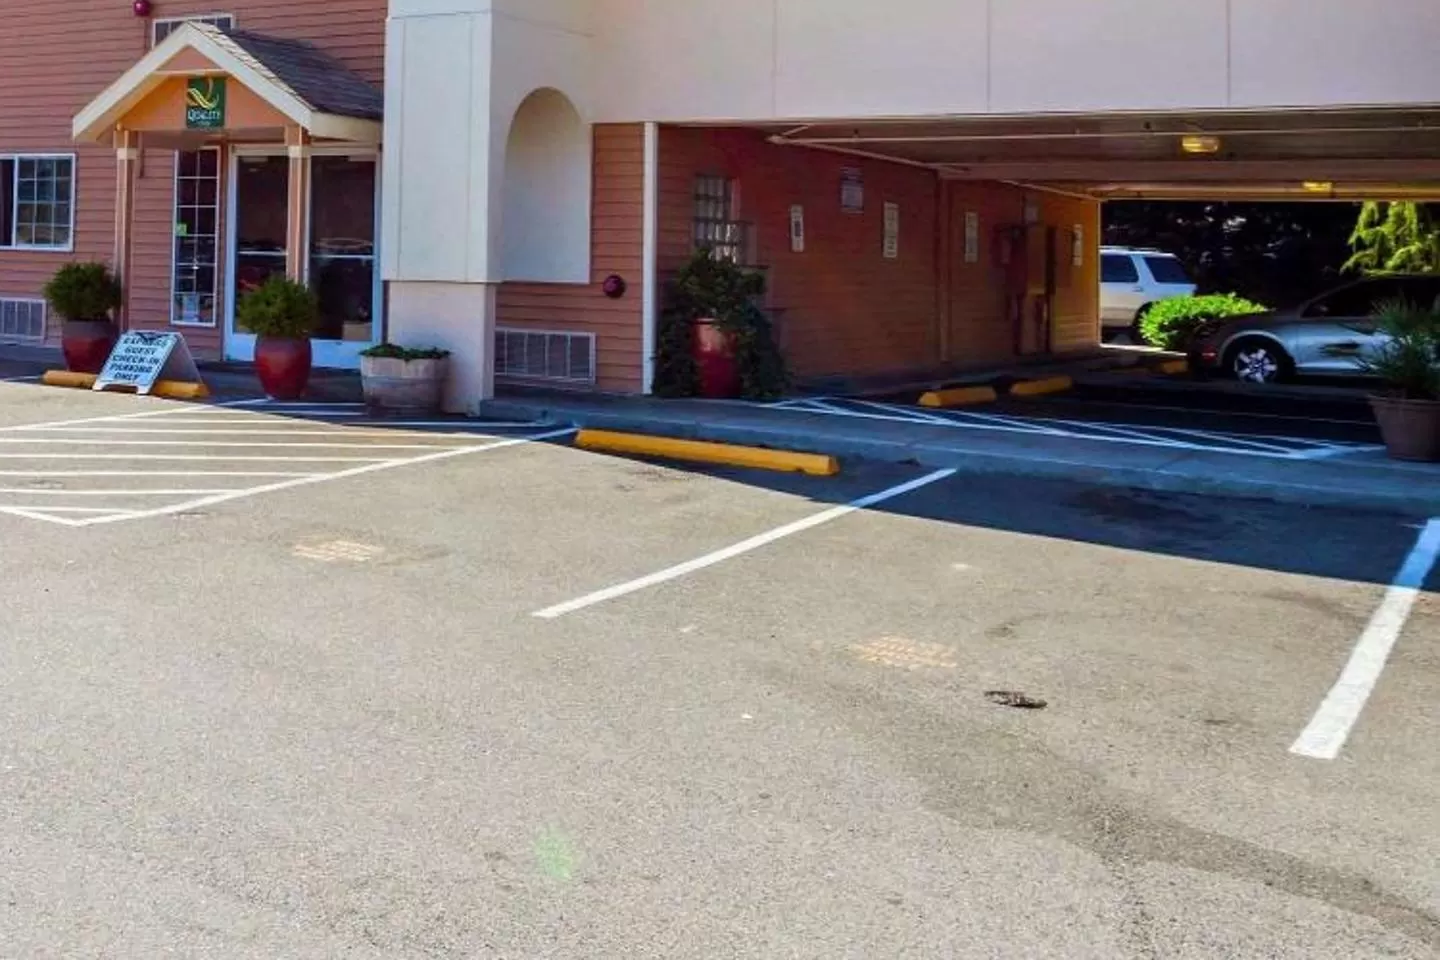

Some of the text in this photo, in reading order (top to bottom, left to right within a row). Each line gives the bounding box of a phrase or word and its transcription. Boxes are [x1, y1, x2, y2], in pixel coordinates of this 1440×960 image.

[124, 346, 157, 355] GUEST
[109, 362, 153, 373] PARKING
[114, 371, 141, 381] ONLY
